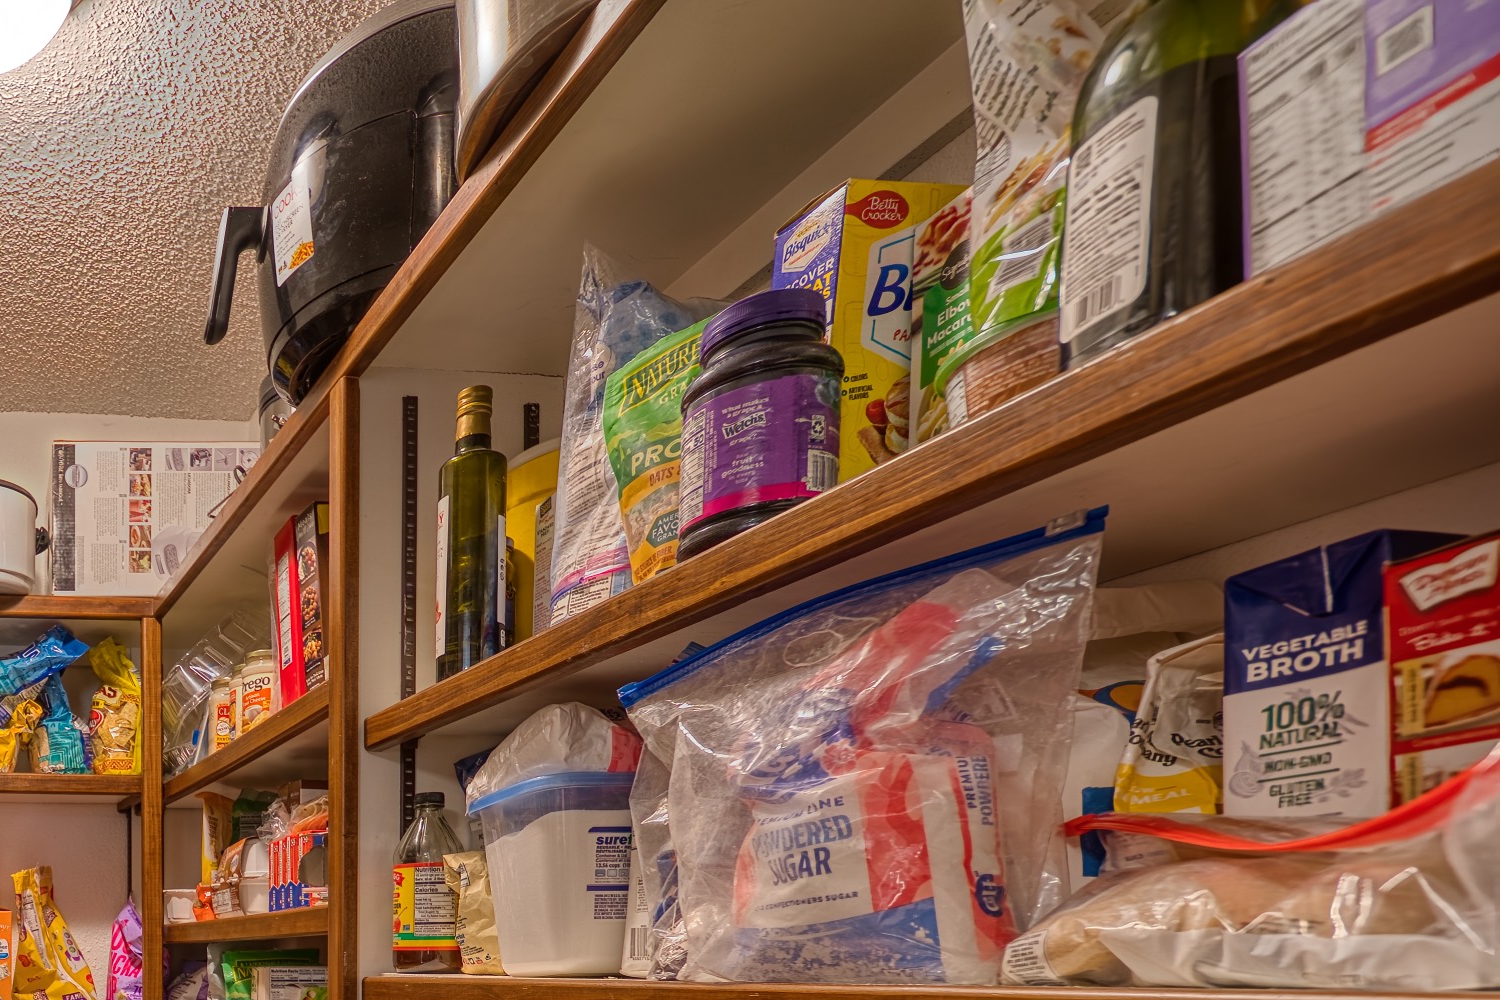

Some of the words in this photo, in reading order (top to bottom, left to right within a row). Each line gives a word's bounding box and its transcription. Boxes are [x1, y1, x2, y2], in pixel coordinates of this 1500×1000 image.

[861, 206, 904, 221] Crocker
[871, 196, 899, 213] Betty
[784, 222, 831, 263] Bisquick
[628, 341, 702, 405] NATURE
[851, 373, 868, 382] COLORS
[849, 385, 873, 394] ARTIFICIAL
[849, 392, 870, 401] FLAVORS
[724, 413, 766, 437] Welch's
[649, 466, 675, 486] OATS
[721, 461, 765, 479] goodness
[1242, 620, 1369, 661] VEGETABLE
[1246, 639, 1365, 683] BROTH
[1261, 690, 1345, 732] 100%
[1259, 721, 1343, 751] NATURAL
[1262, 752, 1333, 775] NON-GMO
[1269, 778, 1325, 798] GLUTEN
[1278, 793, 1313, 808] FREE
[752, 814, 853, 857] POWDERED
[767, 846, 833, 886] SUGAR
[765, 896, 823, 911] CONFECTIONERS
[825, 891, 859, 903] SUGAR
